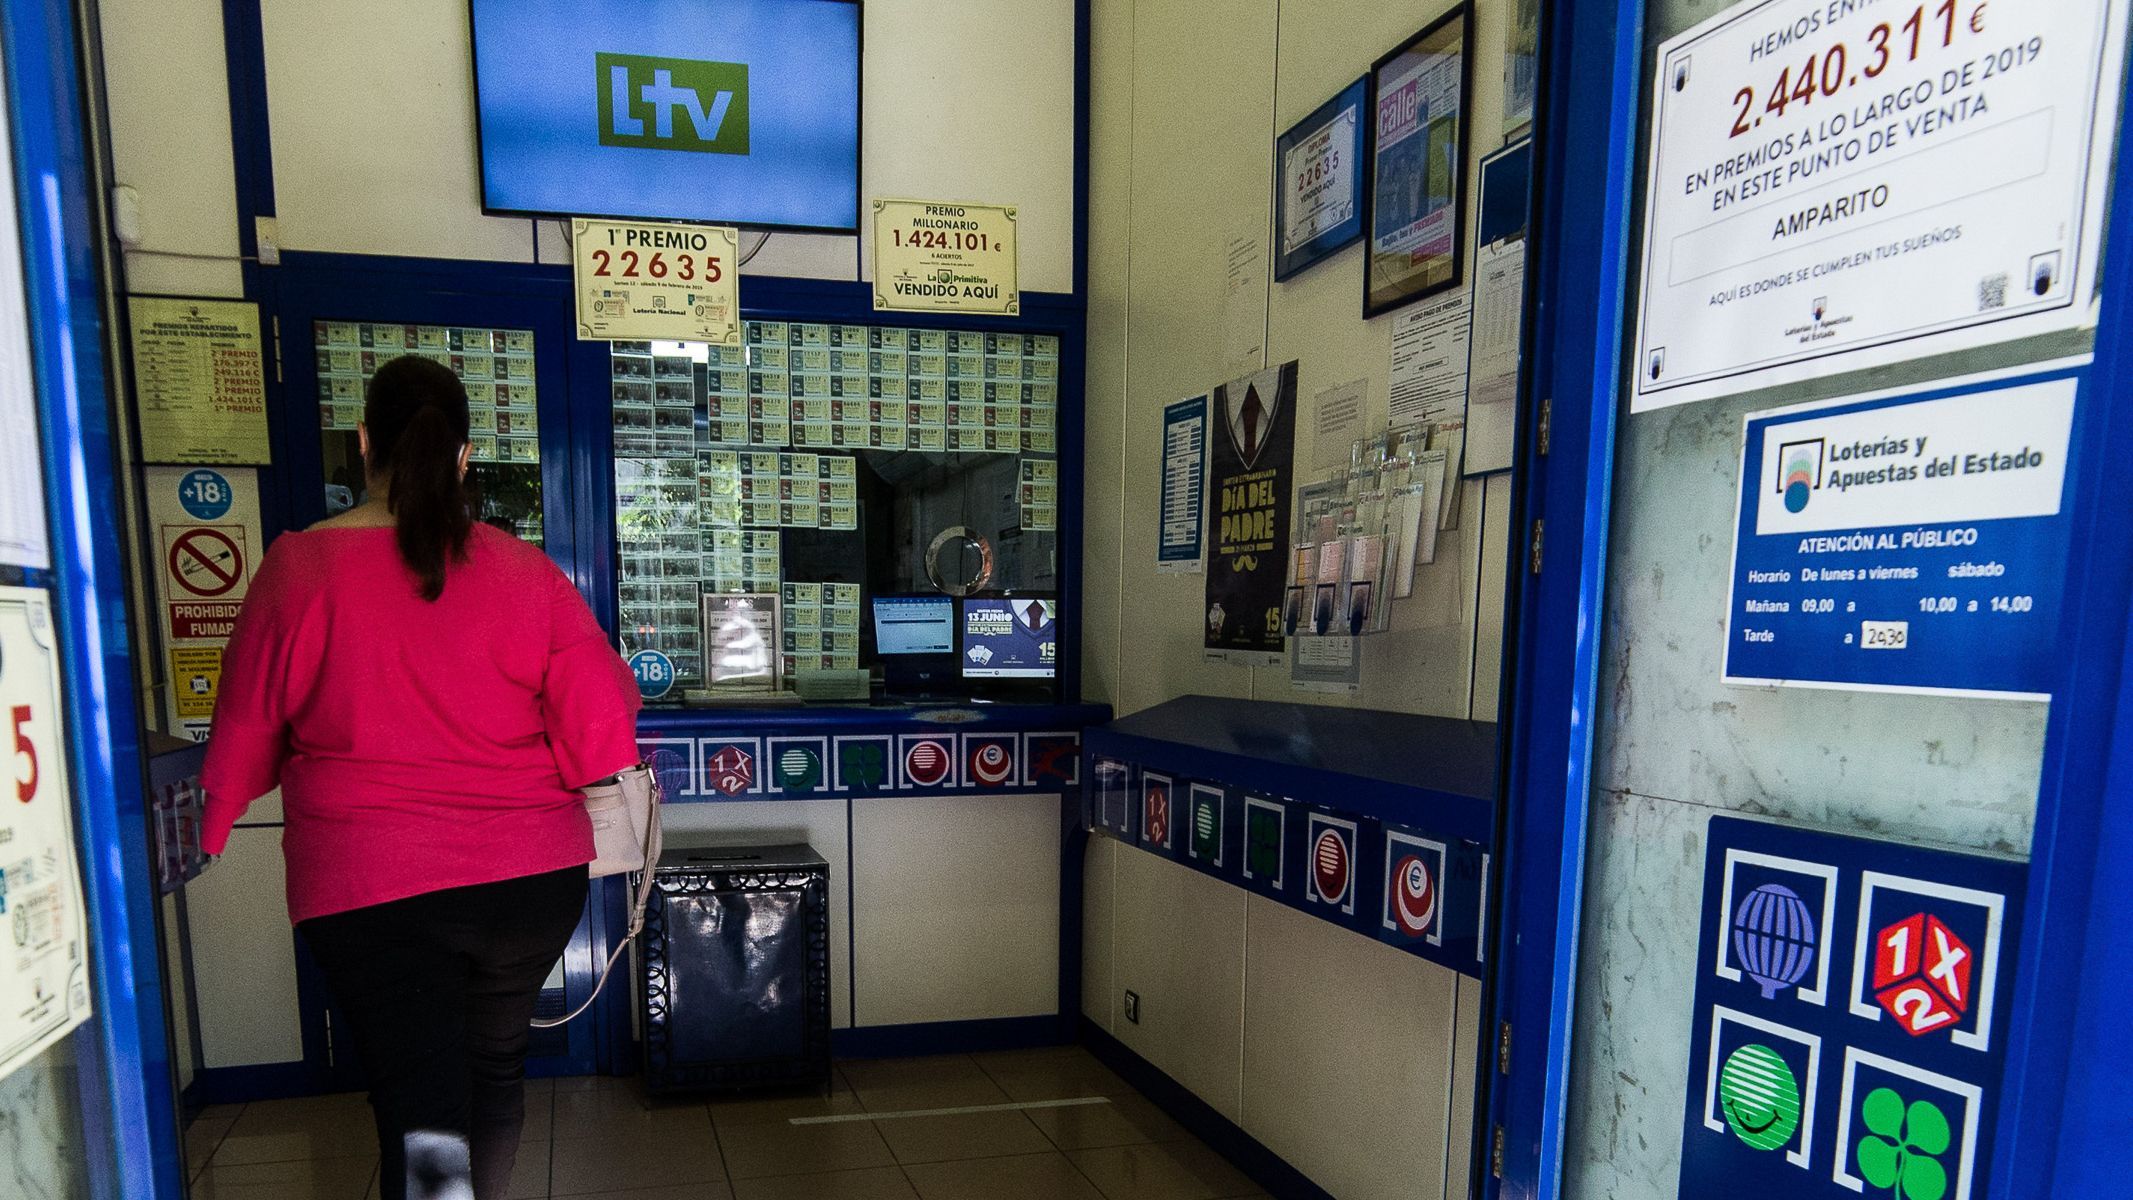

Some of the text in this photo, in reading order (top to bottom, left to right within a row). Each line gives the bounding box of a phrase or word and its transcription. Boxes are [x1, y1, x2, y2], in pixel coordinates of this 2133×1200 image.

[1750, 17, 1820, 63] HEMOS
[1729, 0, 1987, 138] 2.440.311 €
[1379, 89, 1415, 136] calle
[1685, 35, 2042, 195] EN PREMIOS A LO LARGO DE 2019
[1712, 92, 1989, 213] EN ESTE PUNTO DE VENTA
[1298, 150, 1339, 192] 22635
[925, 206, 965, 217] PREMIO
[1772, 183, 1889, 240] AMPARITO
[913, 218, 979, 231] MILLONARIO
[626, 229, 707, 251] PREMIO
[893, 229, 1001, 252] 1.424.101 €
[592, 249, 722, 283] 22635
[1709, 224, 1962, 307] AQUÍ ES DONDE SE CUMPLEN TUS SUEÑOS
[927, 274, 937, 282] La
[953, 274, 988, 284] Primitiva
[894, 282, 998, 299] VENDIDO AQUÍ
[658, 308, 686, 316] Nacional
[180, 330, 252, 339] ESTABLECIMIENTO
[190, 323, 238, 331] REPARTIDOS
[224, 378, 260, 386] PREMIO
[224, 387, 261, 395] PREMIO
[226, 405, 262, 413] PREMIO
[1830, 435, 1927, 462] Loterías y
[1827, 447, 2043, 492] Apuestas del Estado
[183, 482, 221, 503] +18
[1248, 480, 1276, 509] DEL
[1220, 509, 1275, 544] PADRE
[1798, 527, 1978, 553] ATENCIÓN AL PÚBLICO
[1748, 561, 2005, 583] Horario De lunes a viernes sábado
[1745, 596, 2033, 613] Mañana 09,00 a 10,00 a 14,00
[967, 612, 1013, 622] 13 JUNIO
[1265, 607, 1280, 632] 15
[1743, 629, 1853, 644] Tarde a
